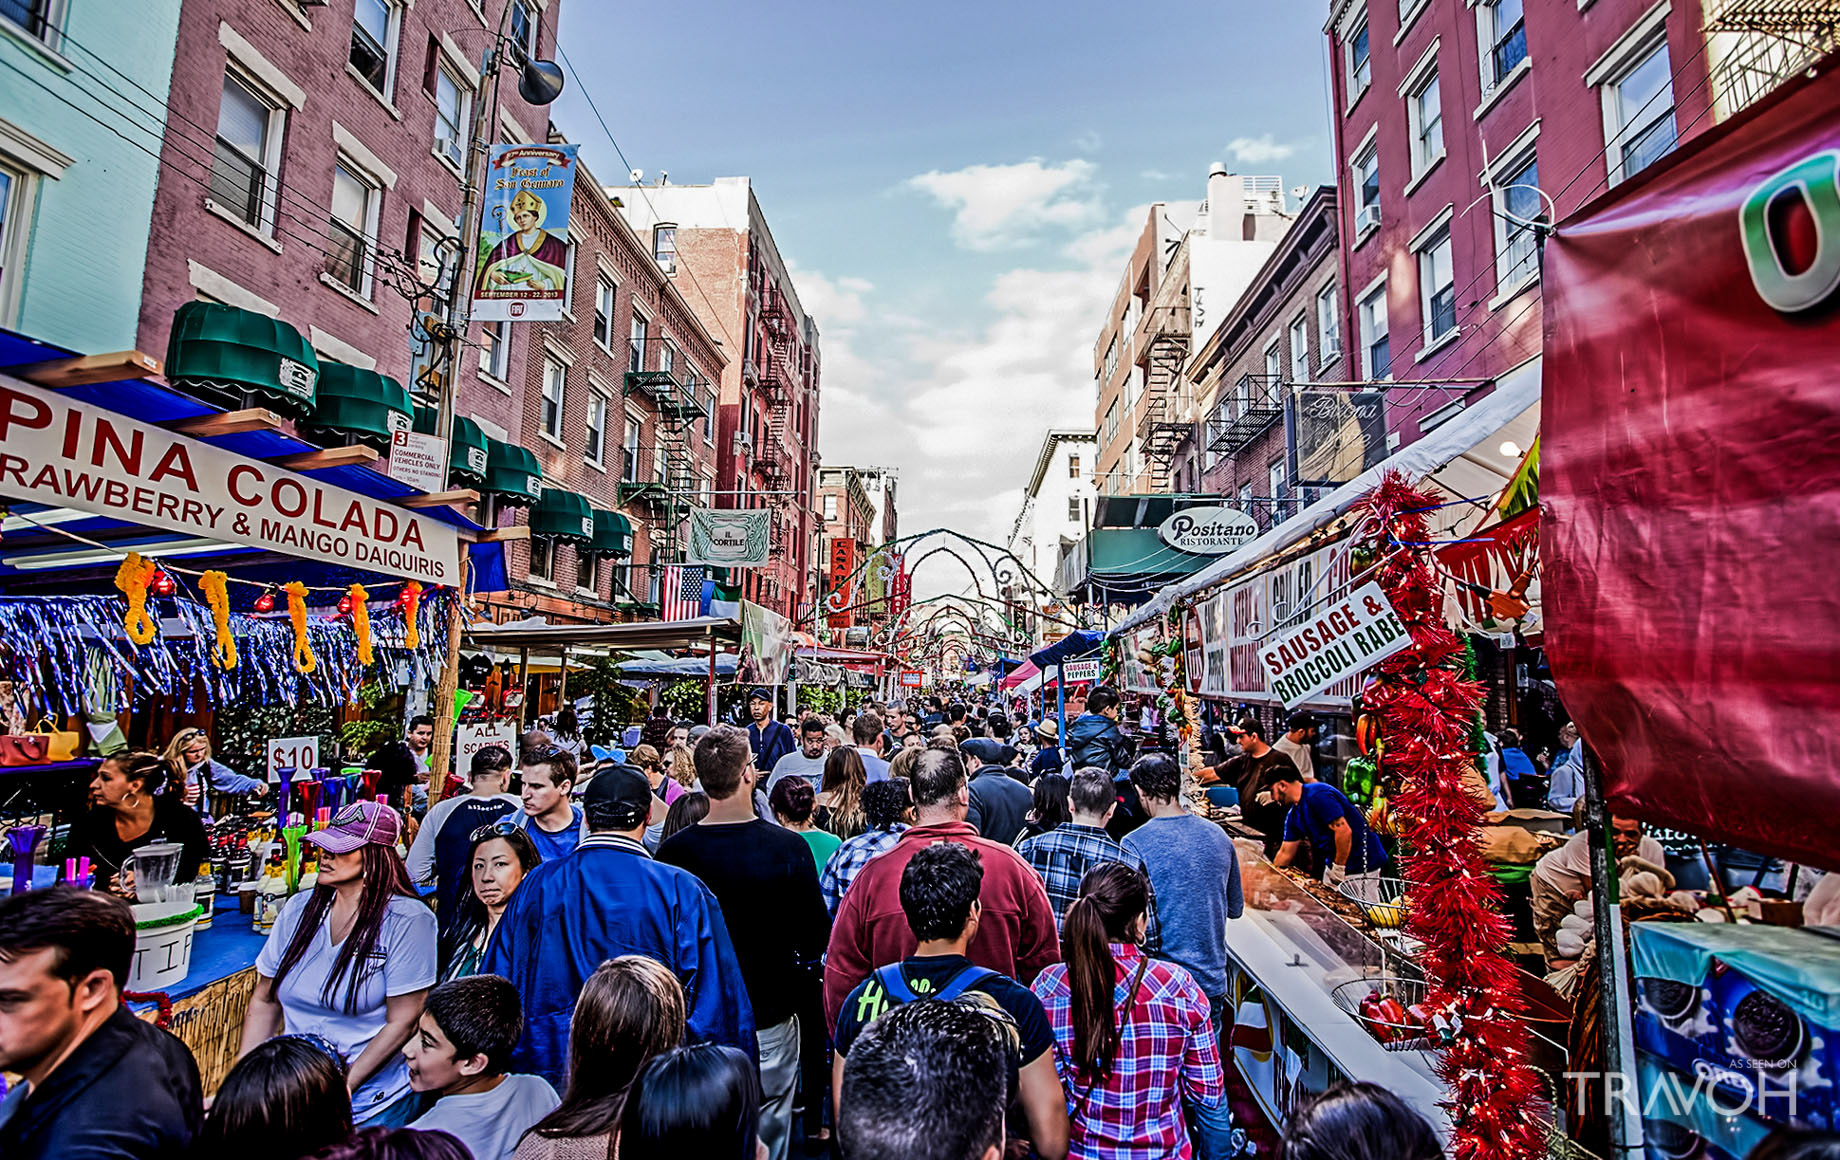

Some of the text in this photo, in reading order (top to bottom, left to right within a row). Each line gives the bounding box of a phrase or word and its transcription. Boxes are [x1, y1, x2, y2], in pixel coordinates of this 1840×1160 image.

[519, 150, 560, 159] Anniversary
[511, 166, 552, 178] Feast of
[495, 178, 564, 190] San Gennaro
[0, 385, 200, 493] PINA
[396, 432, 406, 445] 3
[395, 449, 434, 462] COMMERCIAL
[394, 457, 440, 470] VEHICLES ONLY
[393, 465, 411, 473] OTHERS
[420, 470, 441, 478] STANDING
[227, 464, 425, 552] COLADA
[0, 453, 444, 578] RAWBERRY & MANGO DAIQUIRIS
[1171, 515, 1255, 541] Positano
[714, 539, 745, 547] CORTILE
[1180, 537, 1243, 546] RISTORANTE
[835, 541, 847, 570] CASA
[1264, 603, 1361, 675] SAUSAGE
[1363, 595, 1384, 616] &
[1274, 641, 1357, 703] BROCCOLI
[1352, 612, 1406, 657] RABE
[1065, 663, 1092, 672] SAUSAGE
[1067, 670, 1096, 679] PEPPERS
[474, 726, 500, 737] ALL
[273, 745, 313, 771] $10
